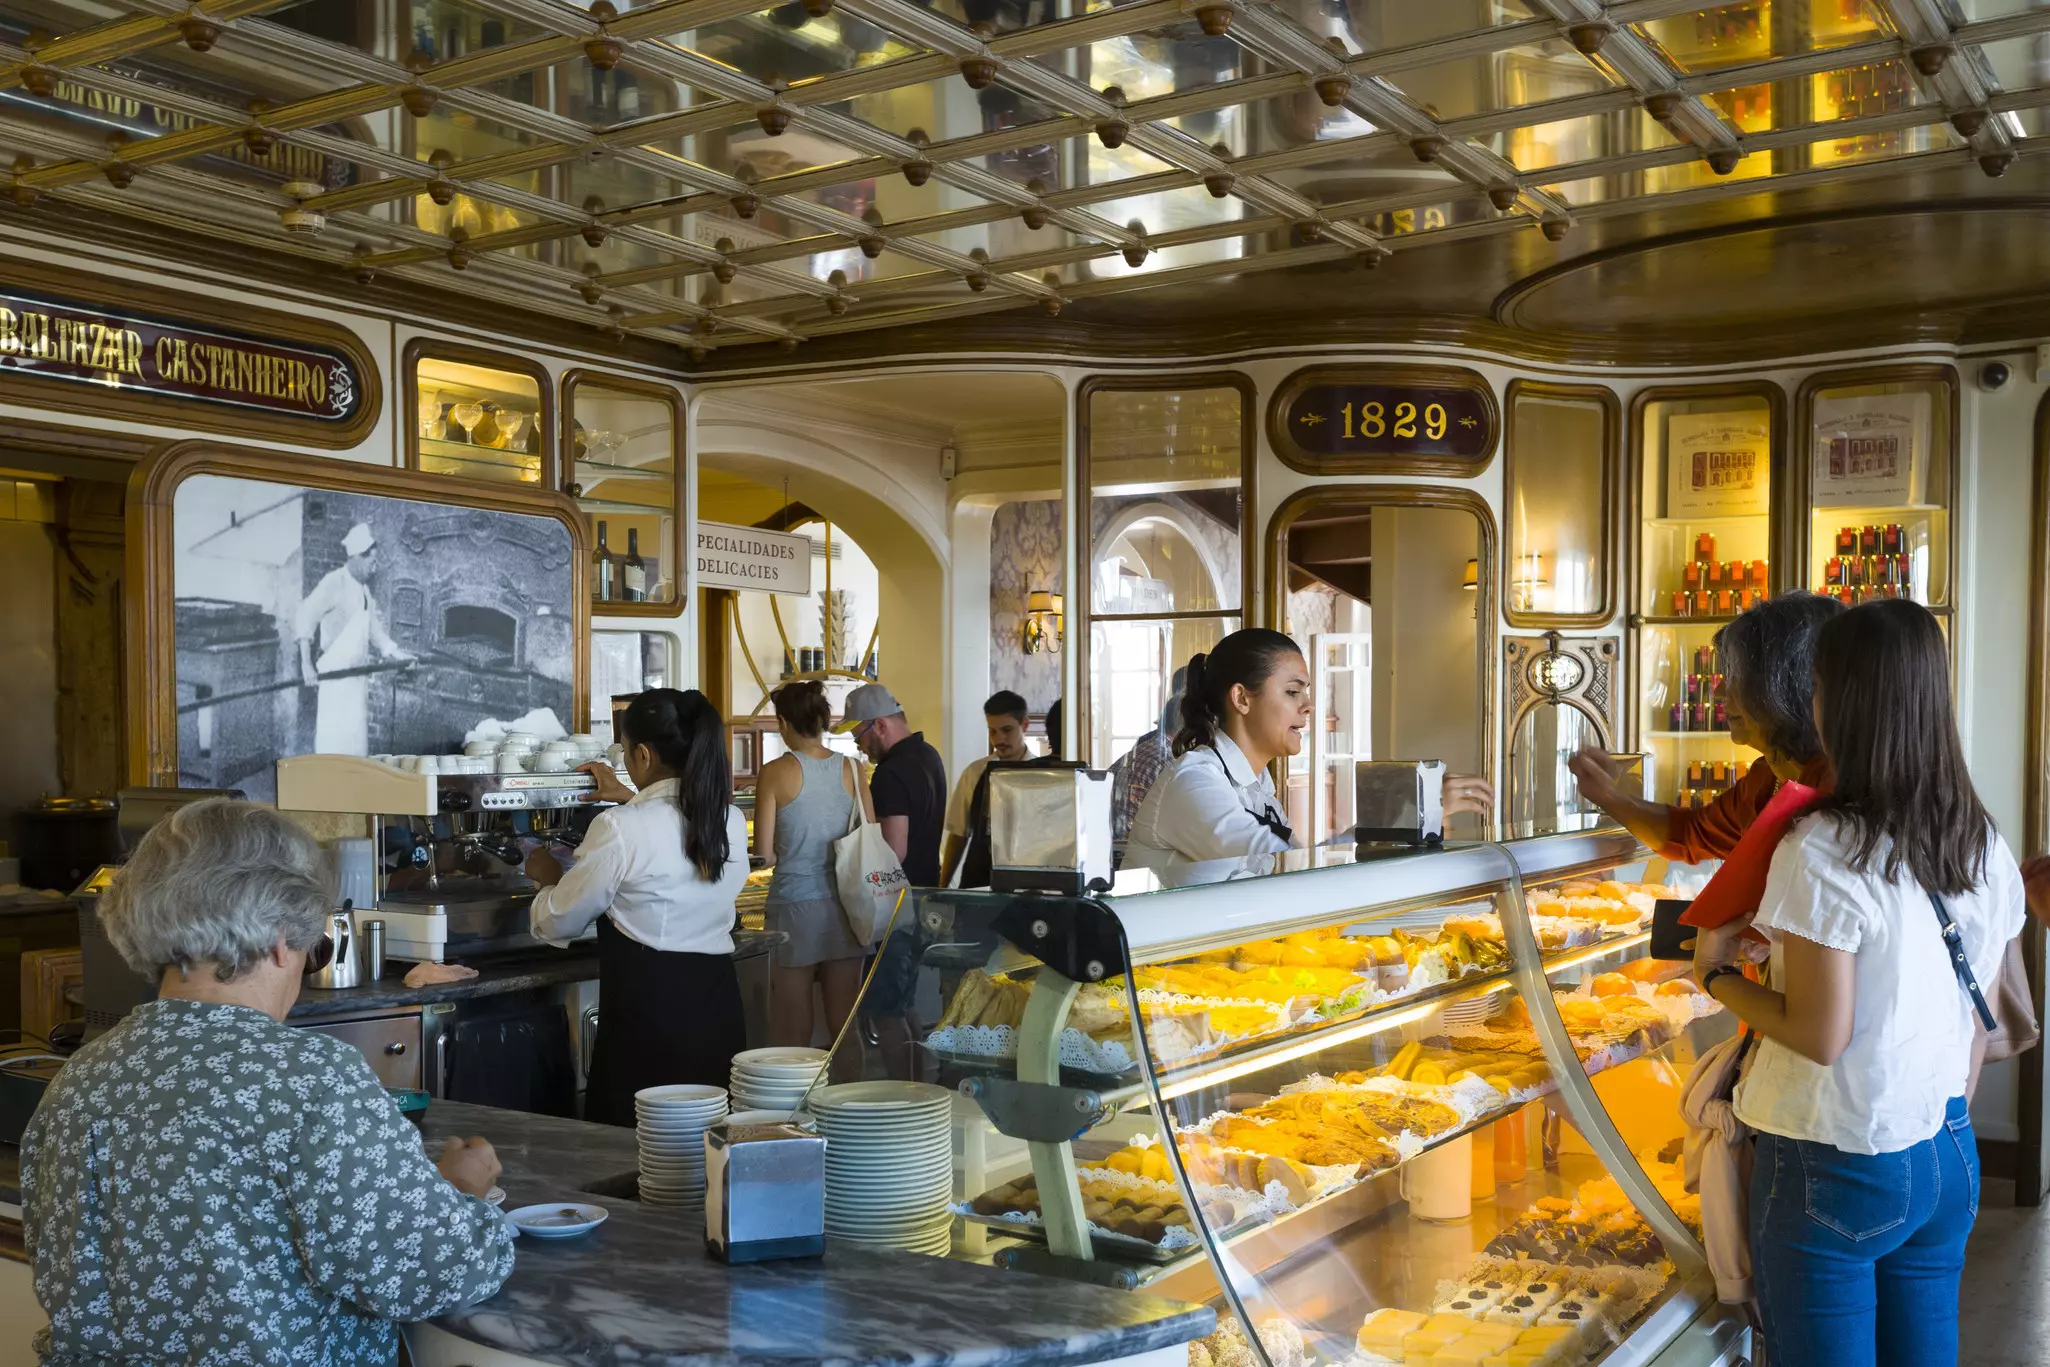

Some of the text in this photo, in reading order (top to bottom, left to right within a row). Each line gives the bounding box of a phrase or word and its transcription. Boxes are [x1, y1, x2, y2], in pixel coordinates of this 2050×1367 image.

[0, 307, 327, 409] BALTAZAR CASTANHEIRO
[1341, 402, 1447, 441] 1829
[697, 558, 779, 580] DELICACIES
